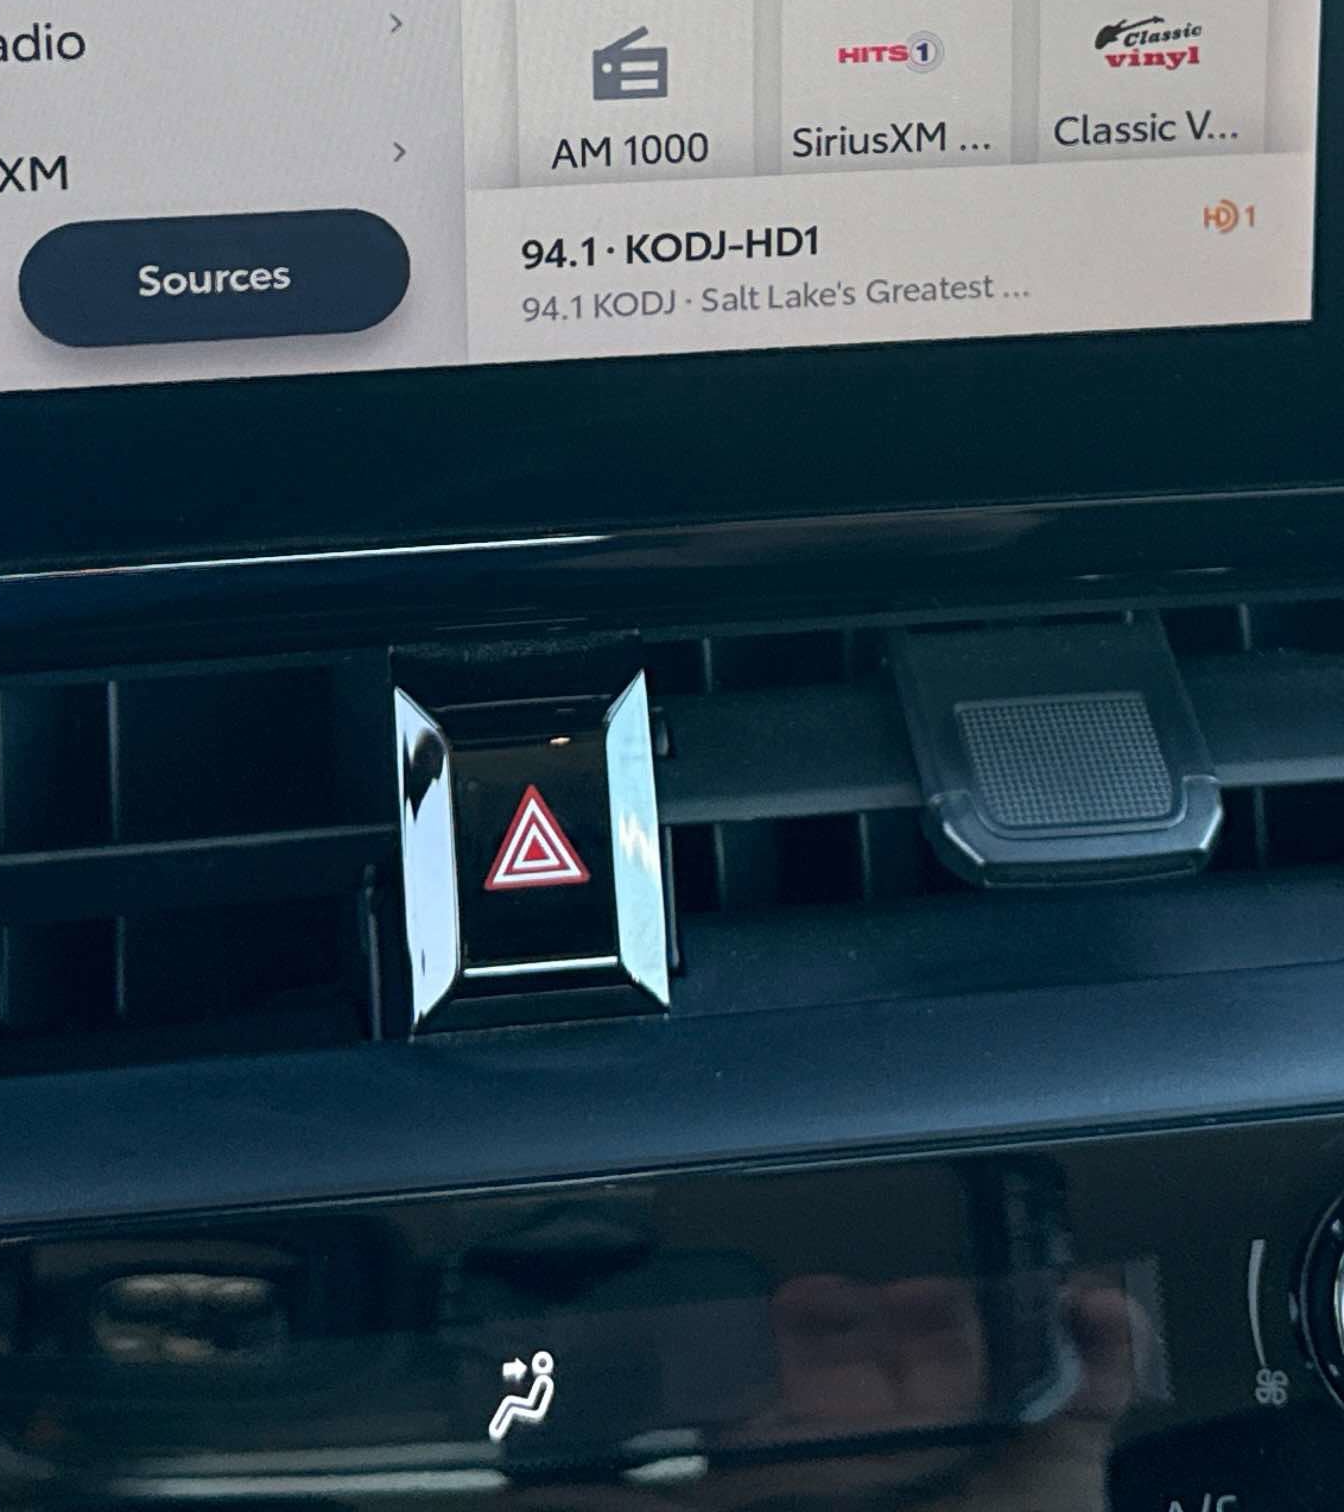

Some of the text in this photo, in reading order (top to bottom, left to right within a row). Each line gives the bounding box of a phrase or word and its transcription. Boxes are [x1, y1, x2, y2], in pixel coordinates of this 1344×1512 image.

[1124, 23, 1202, 47] Classic
[1105, 47, 1200, 70] vinyl
[793, 122, 945, 157] SiriusXM
[1055, 113, 1176, 146] Classic
[552, 133, 708, 169] AM 1000
[522, 237, 594, 269] 94.1
[627, 226, 817, 264] KODJ-HD1
[139, 266, 290, 296] Sources
[523, 296, 581, 322] 94.1
[594, 290, 675, 318] KODJ
[702, 285, 760, 312] Salt
[769, 281, 855, 309] Lake's
[867, 275, 994, 304] Greatest
